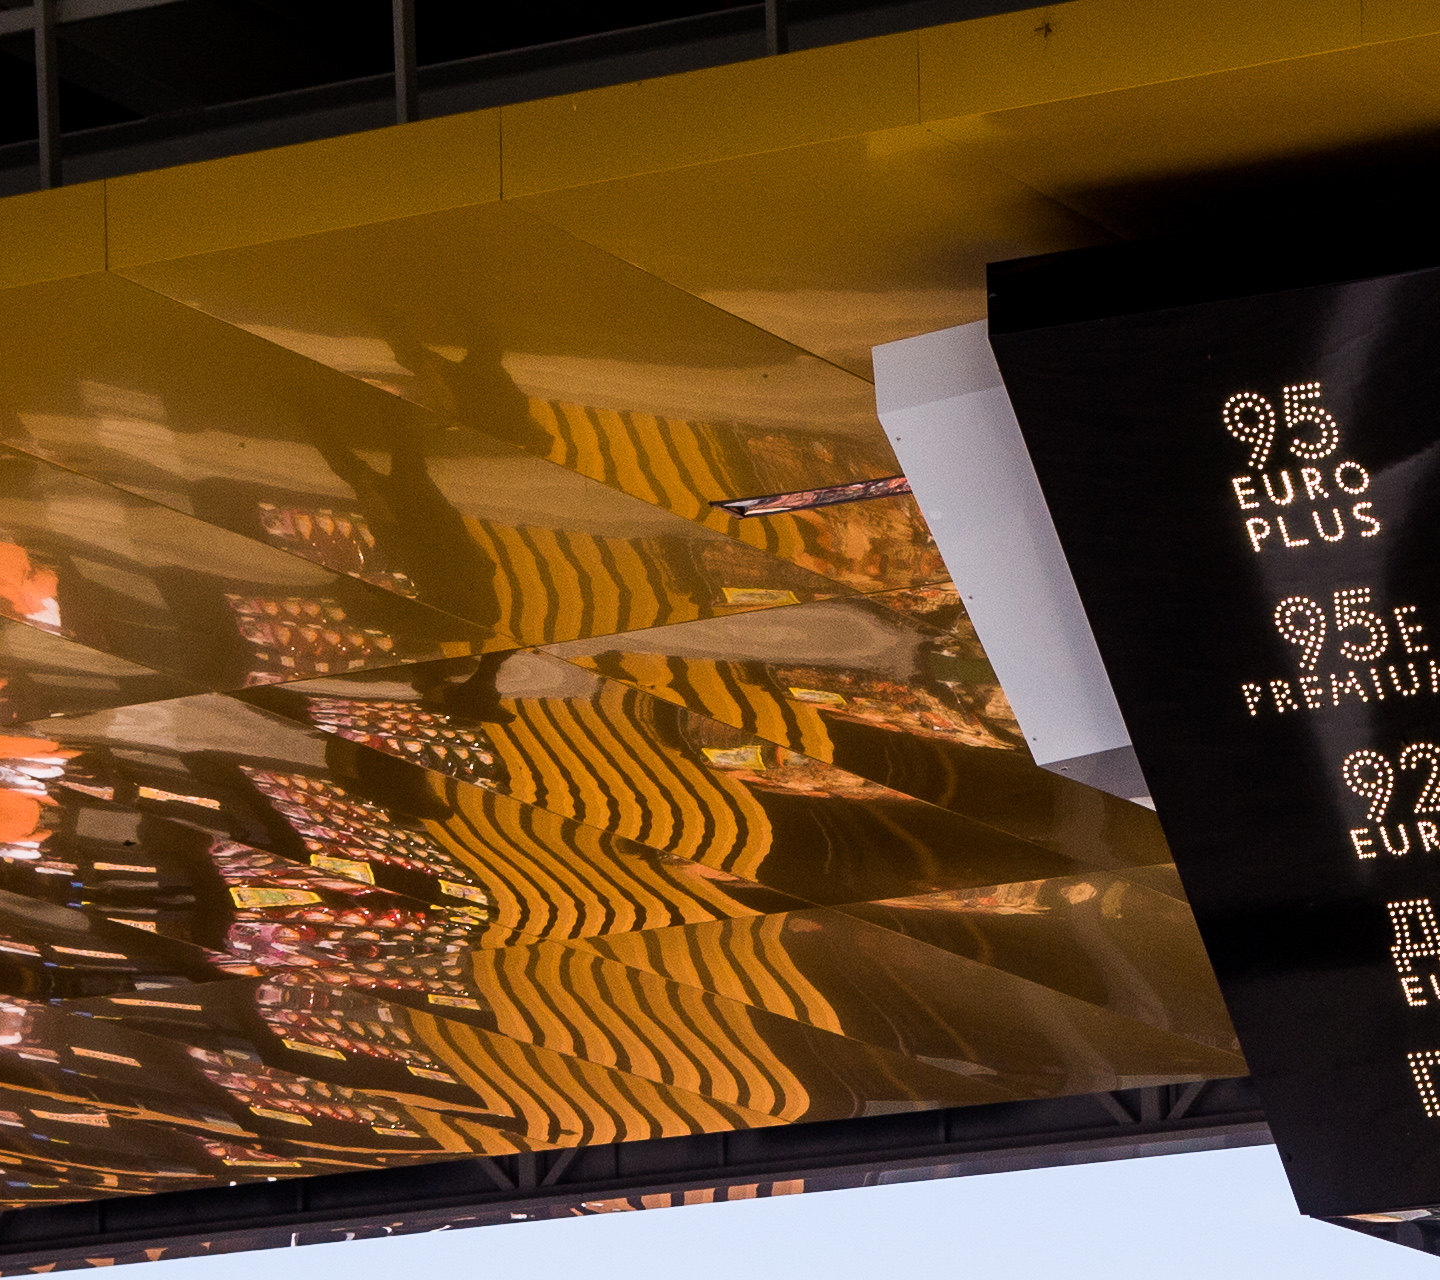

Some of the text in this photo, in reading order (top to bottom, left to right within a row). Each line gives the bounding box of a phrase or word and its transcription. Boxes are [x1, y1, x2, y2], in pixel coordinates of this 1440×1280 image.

[1222, 381, 1340, 471] 95
[1231, 460, 1371, 511] EURO
[1244, 500, 1381, 553] PLUS
